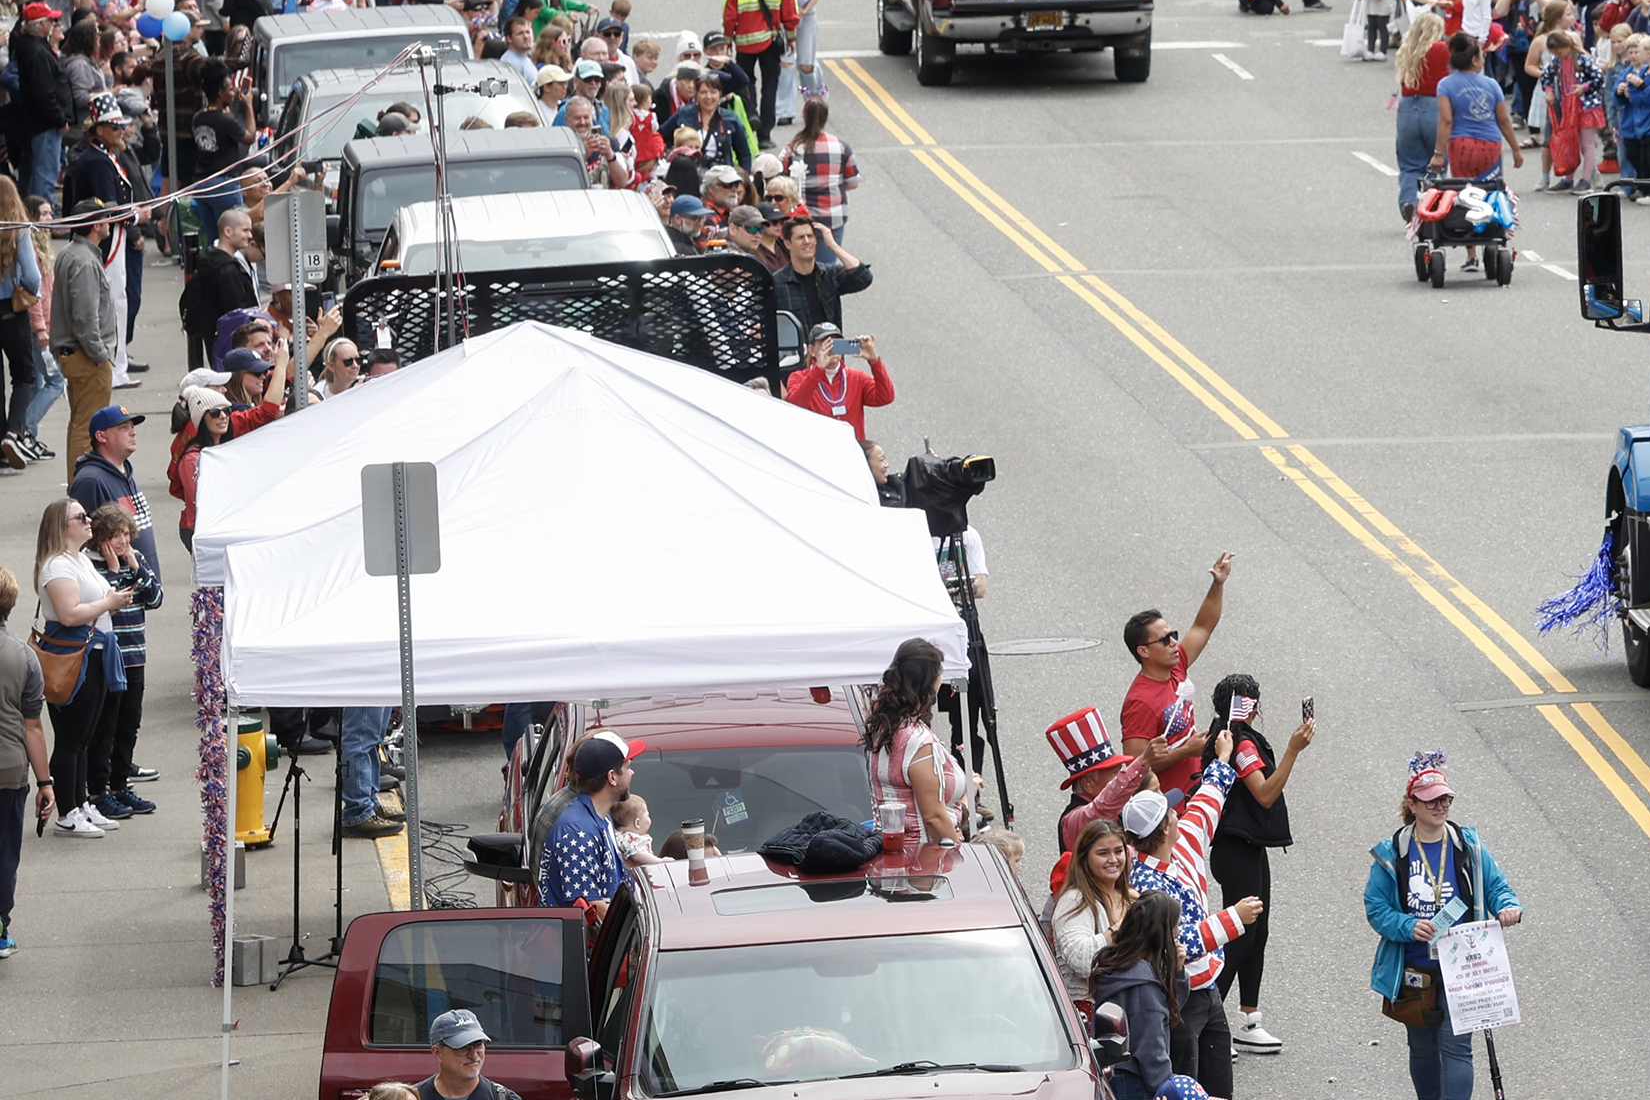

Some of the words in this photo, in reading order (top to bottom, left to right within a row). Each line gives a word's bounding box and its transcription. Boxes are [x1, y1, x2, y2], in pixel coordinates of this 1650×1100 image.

[1416, 186, 1515, 233] USA
[307, 254, 320, 266] 18
[1472, 968, 1482, 976] JULY
[1457, 1000, 1477, 1008] SECOND
